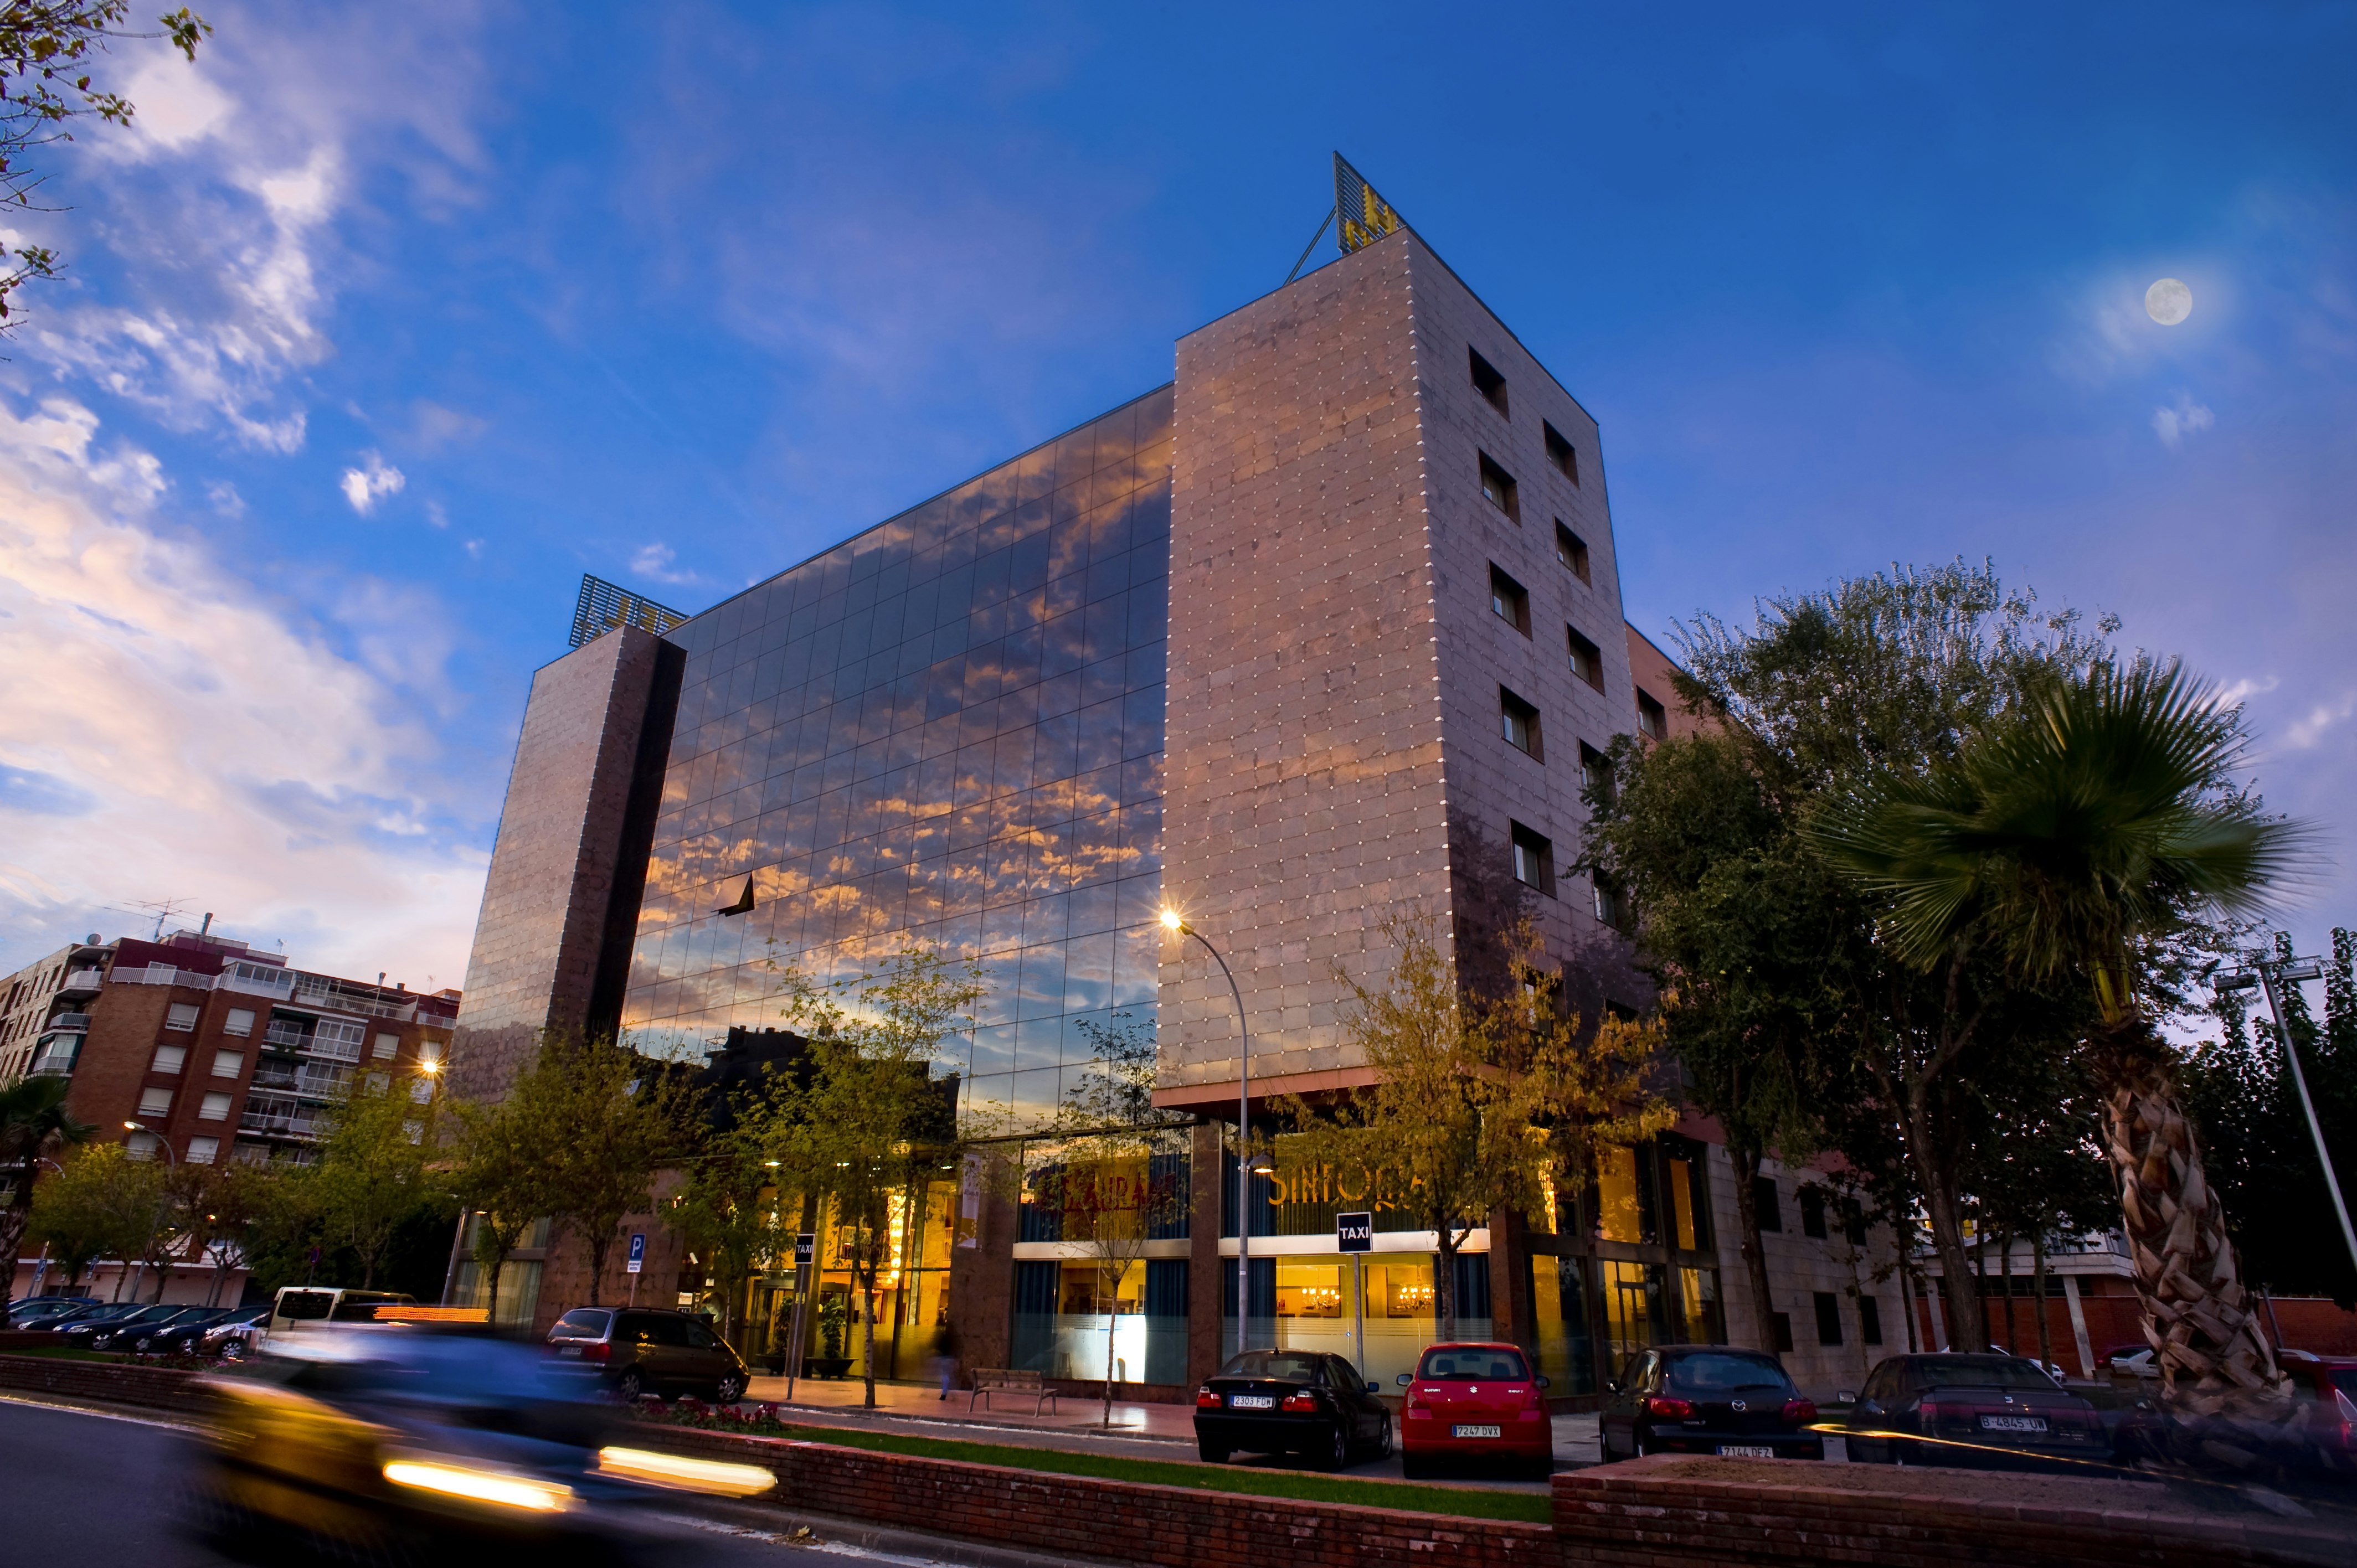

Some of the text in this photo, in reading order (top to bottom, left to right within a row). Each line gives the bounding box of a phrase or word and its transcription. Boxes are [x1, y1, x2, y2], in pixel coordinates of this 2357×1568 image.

[1340, 1226, 1369, 1239] TAXI
[632, 1237, 642, 1257] P
[797, 1245, 812, 1254] TAXI
[1235, 1396, 1271, 1406] 2303 FDW
[1458, 1426, 1498, 1436] 7247 DVX
[1724, 1447, 1748, 1457] 7144
